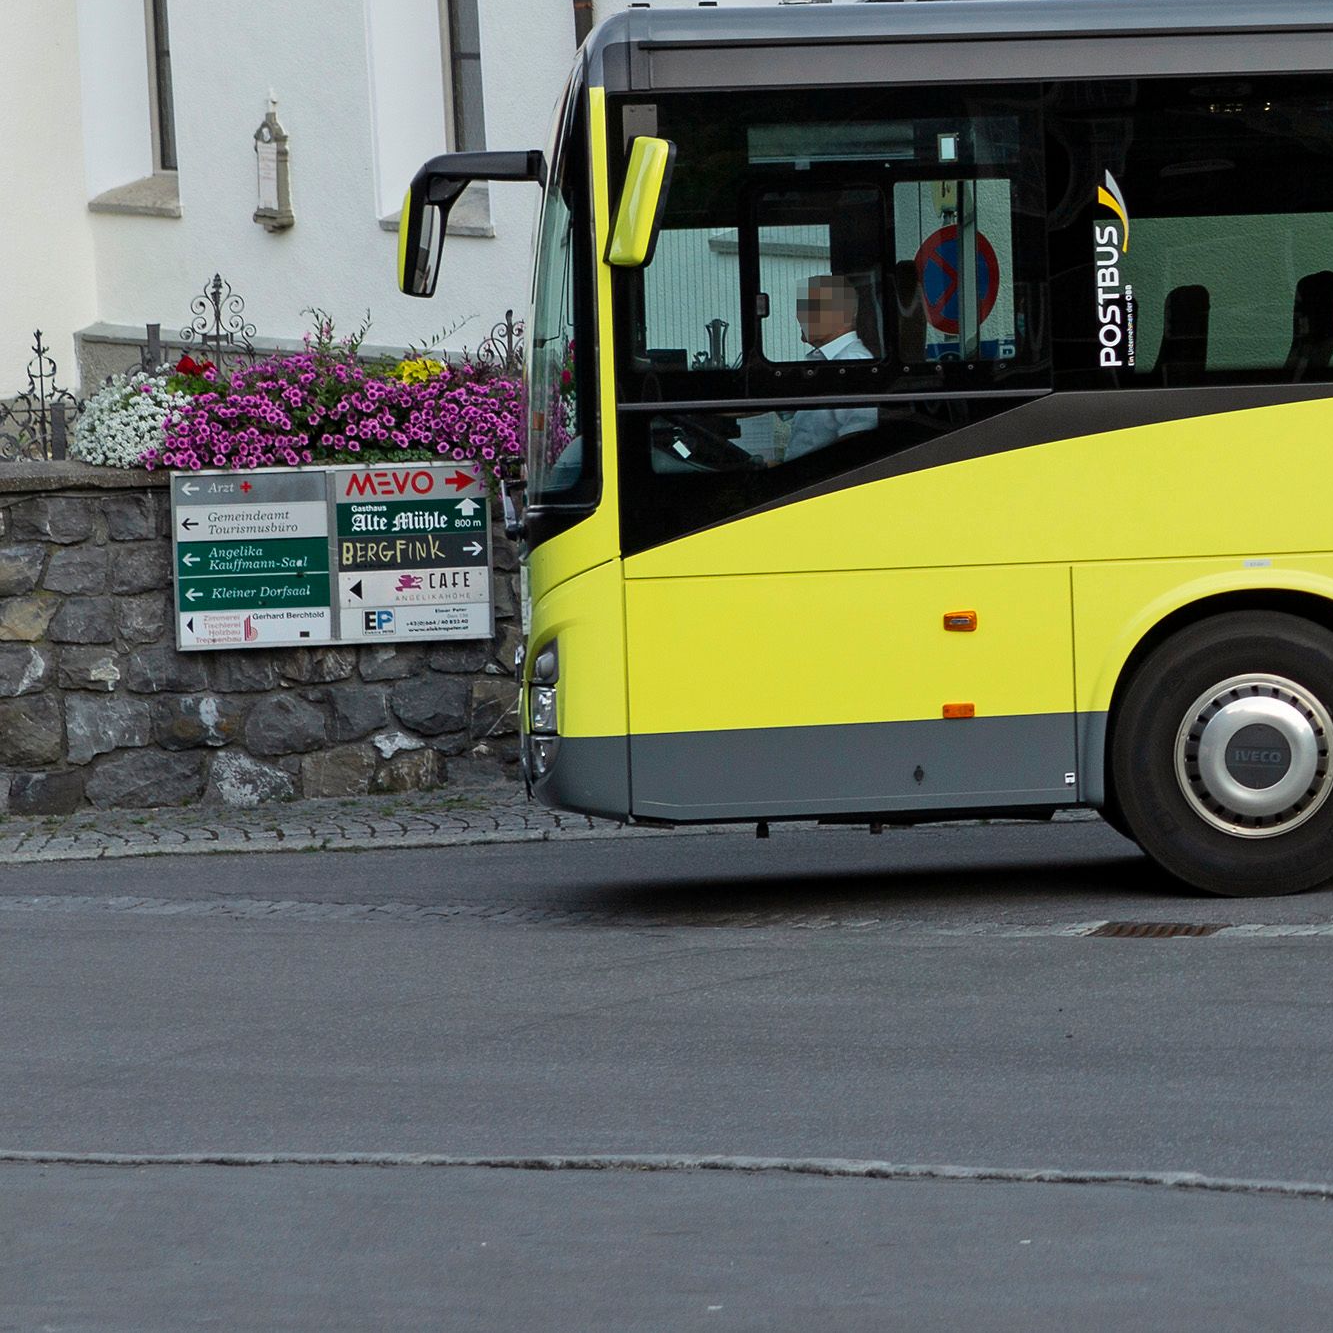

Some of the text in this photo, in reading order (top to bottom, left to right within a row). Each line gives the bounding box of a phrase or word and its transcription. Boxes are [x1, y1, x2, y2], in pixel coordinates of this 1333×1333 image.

[1095, 225, 1123, 367] POSTBUS
[208, 482, 235, 493] Arzt
[345, 470, 434, 496] MEVO
[207, 510, 290, 522] Gemeindeamt
[351, 511, 448, 531] Alte Mühle
[208, 523, 298, 535] Tourismusbüro
[454, 519, 471, 527] 800
[209, 546, 263, 559] Angelika
[342, 534, 446, 565] BERGFINK
[209, 556, 308, 571] Kauffmann-Saal
[429, 571, 470, 588] CAFE
[212, 585, 310, 599] Kleiner Dorfsaal
[395, 592, 471, 602] ANGELIKAHÖHE
[252, 611, 324, 620] Gerhard Berchtold
[364, 610, 394, 630] EP
[1235, 750, 1282, 763] IVECO
